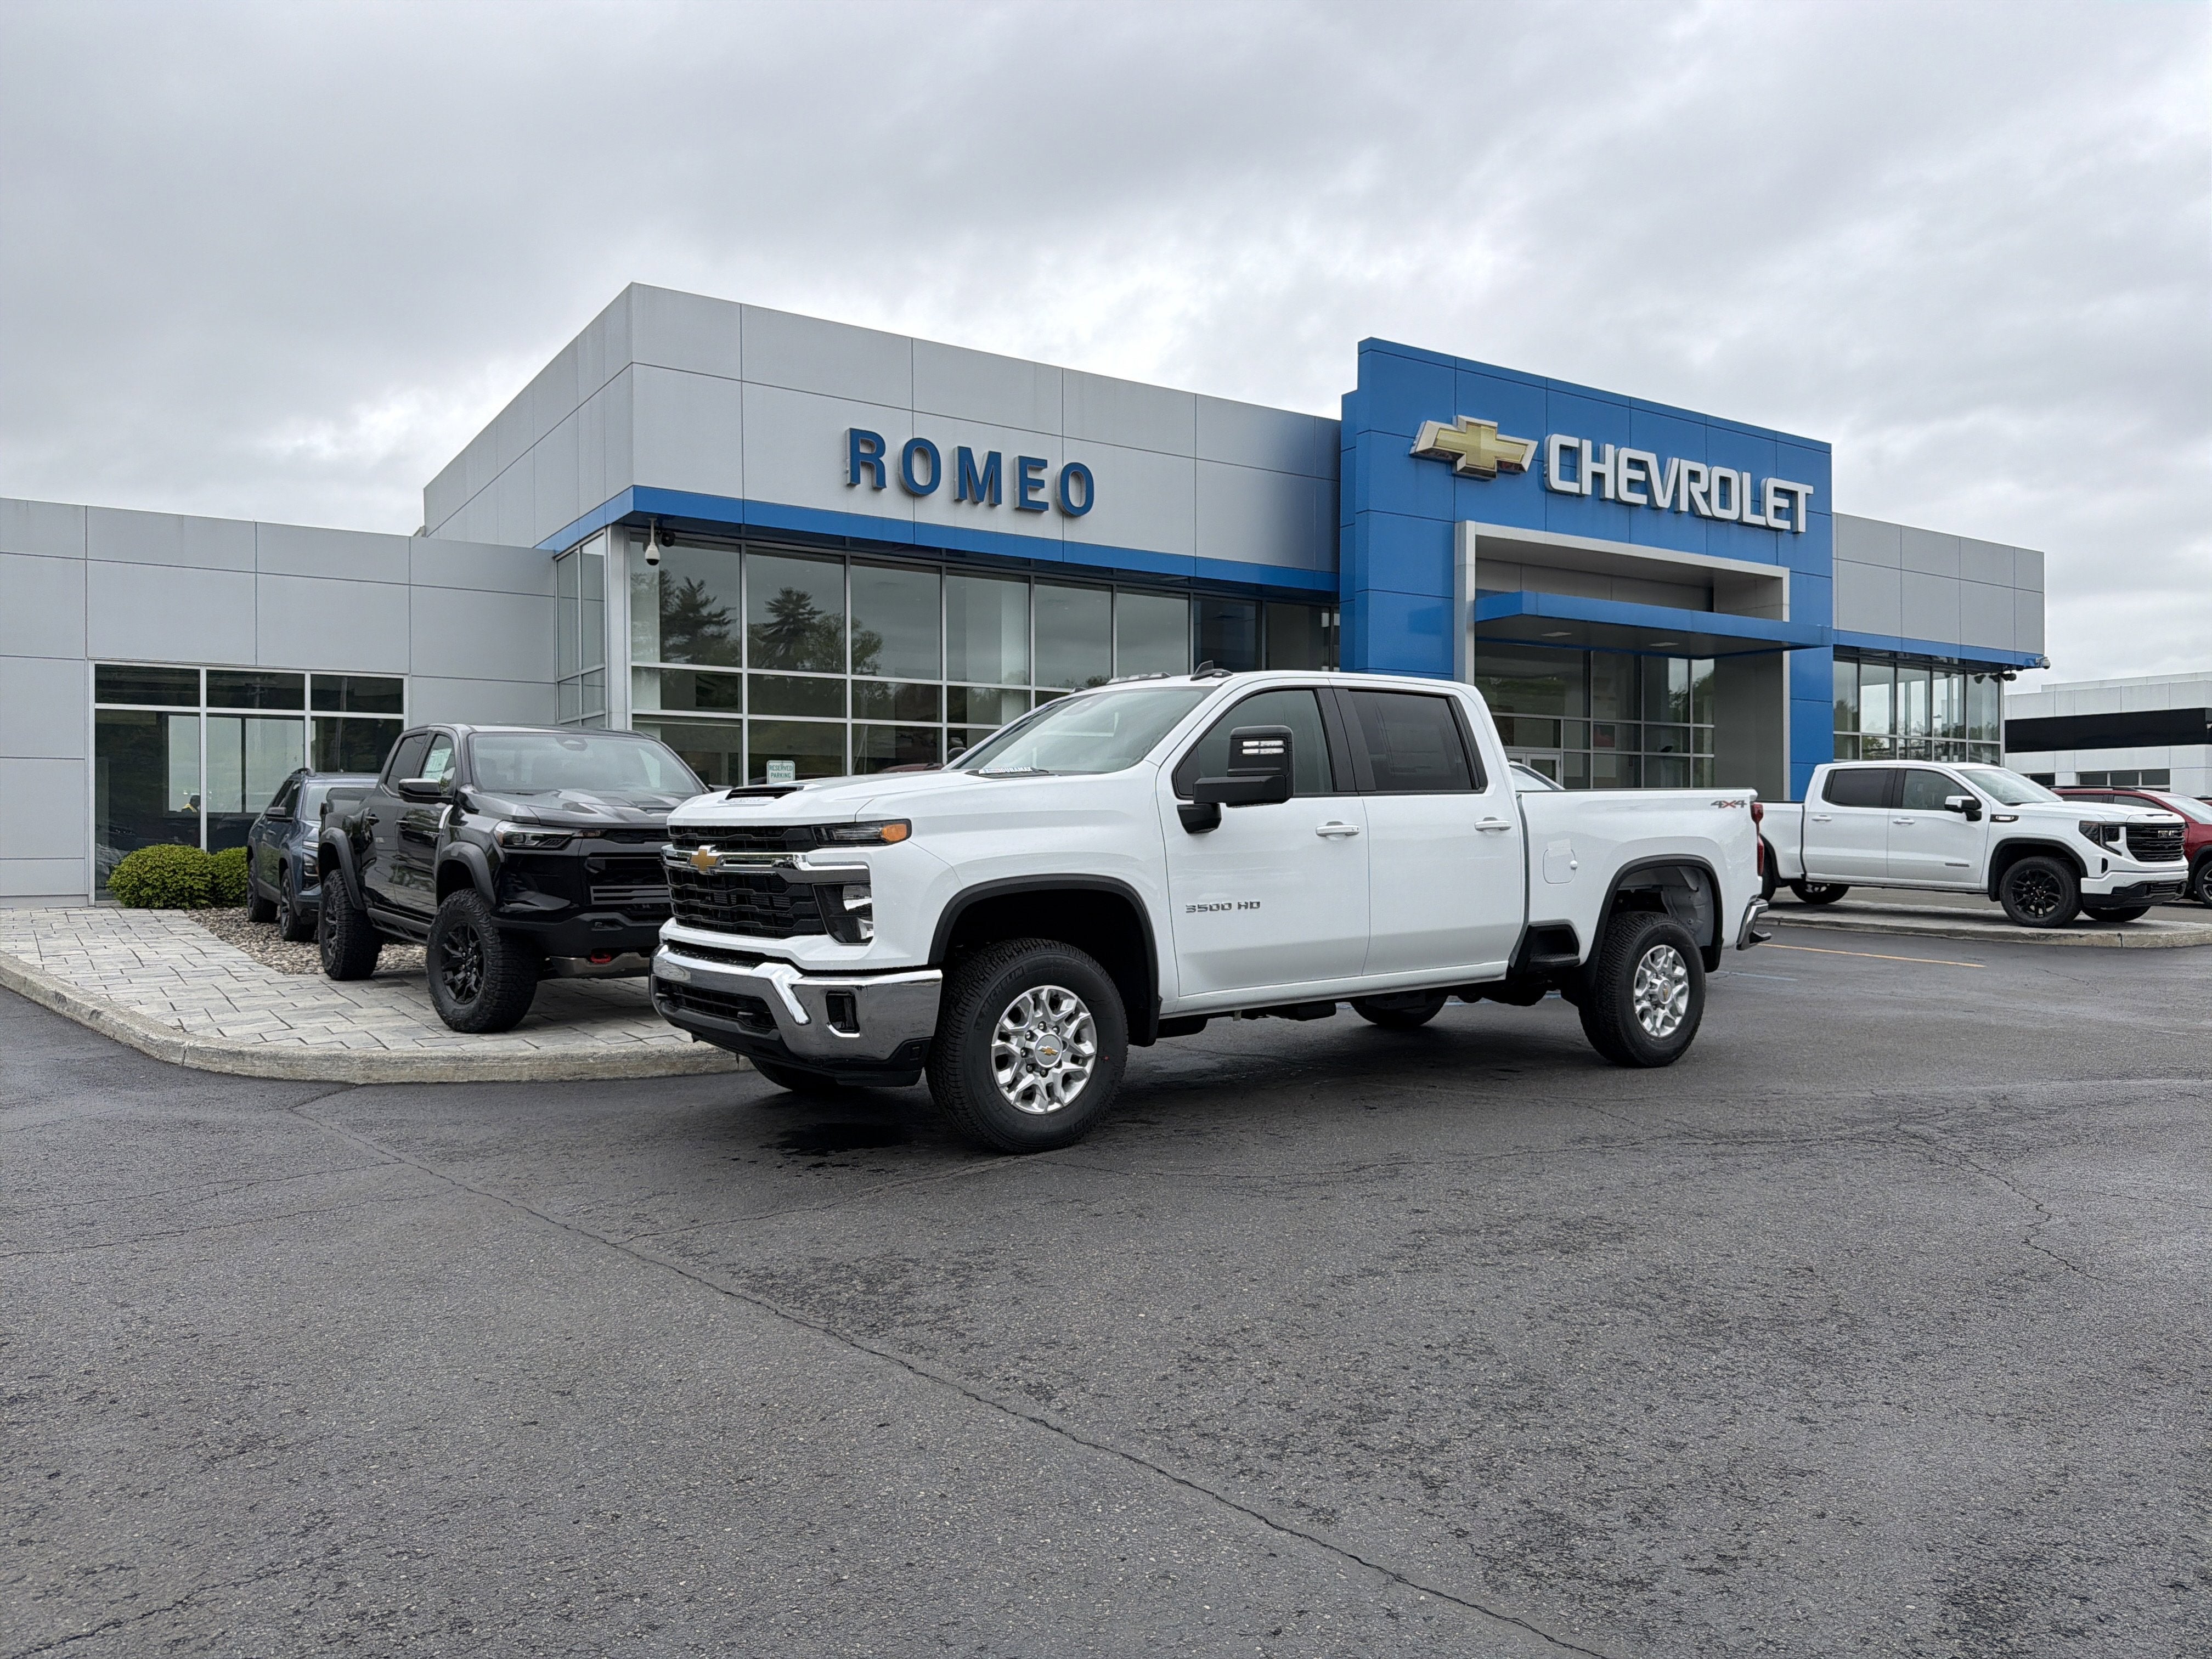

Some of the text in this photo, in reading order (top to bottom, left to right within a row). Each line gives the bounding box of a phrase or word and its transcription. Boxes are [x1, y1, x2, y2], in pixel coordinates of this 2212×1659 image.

[845, 427, 1094, 517] ROMEO
[1543, 433, 1814, 534] CHEVROLET
[1186, 901, 1260, 913] 3500 HD
